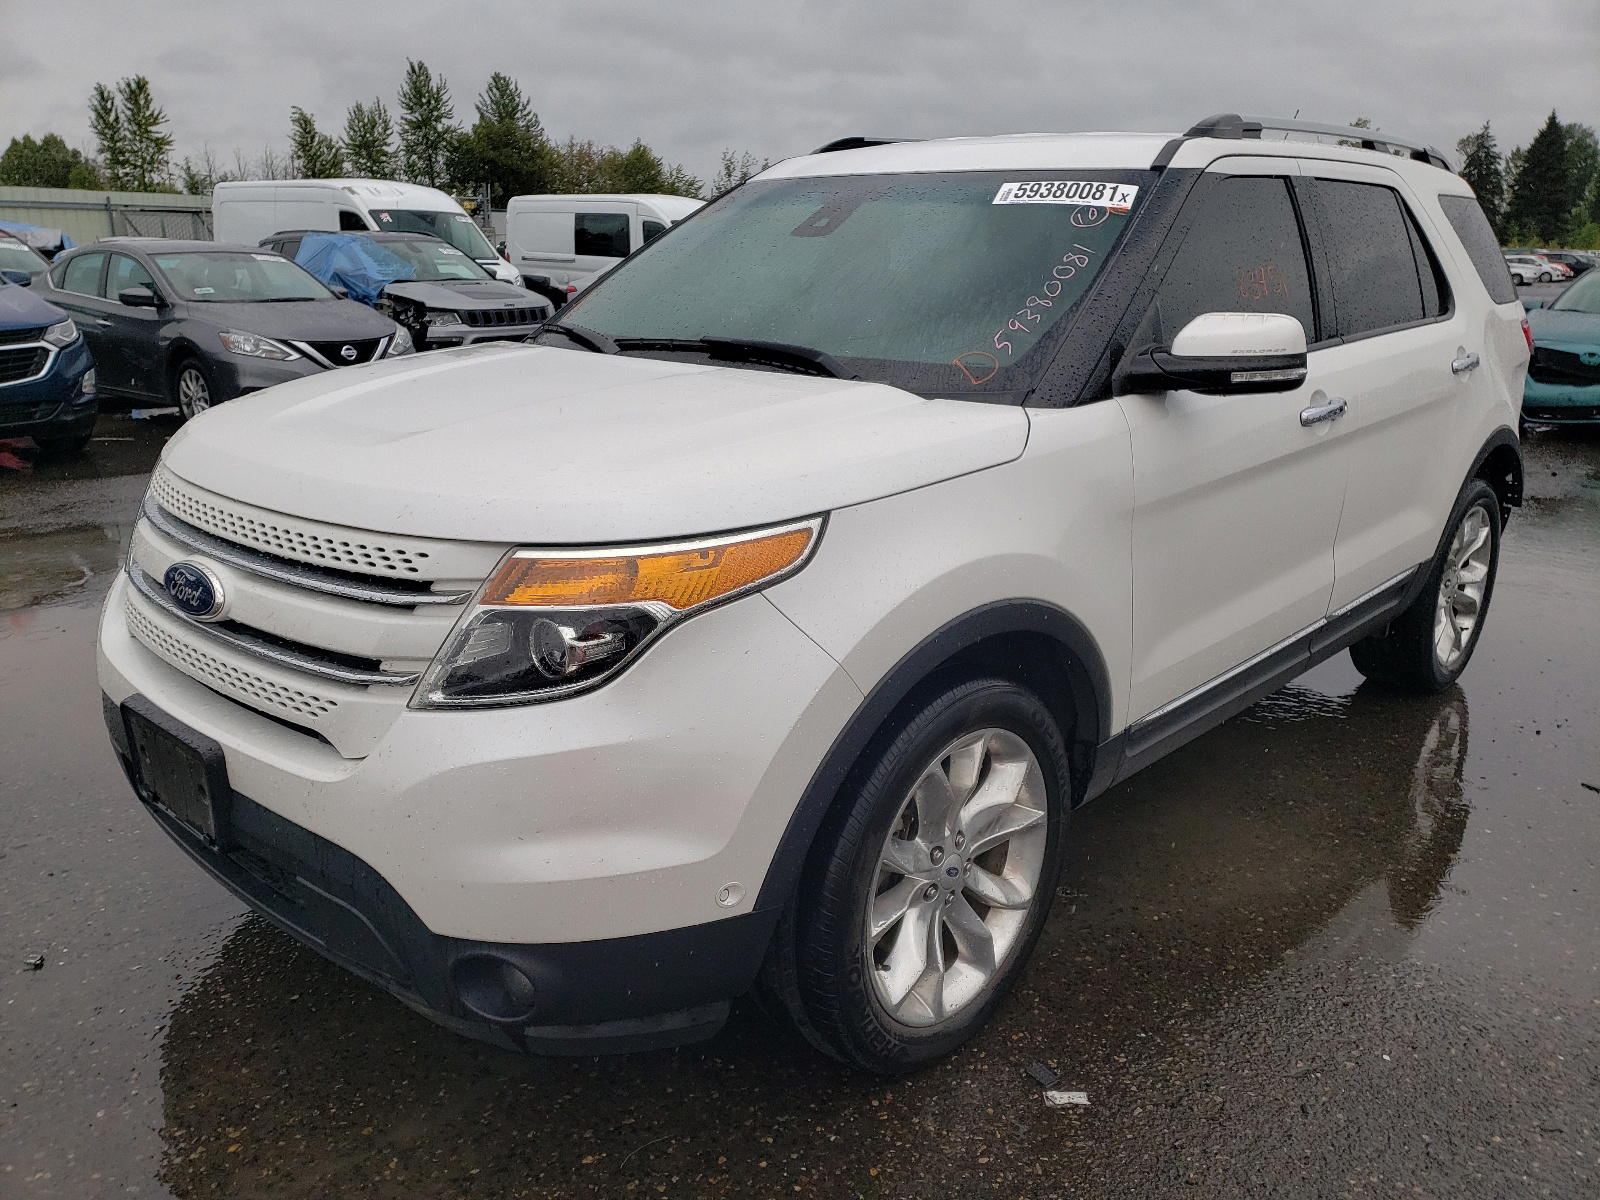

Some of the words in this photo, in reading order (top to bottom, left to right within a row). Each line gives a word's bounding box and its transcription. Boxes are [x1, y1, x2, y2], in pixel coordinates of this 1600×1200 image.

[1013, 182, 1119, 202] 59380081
[994, 243, 1096, 356] 59380081
[170, 568, 203, 607] Ford
